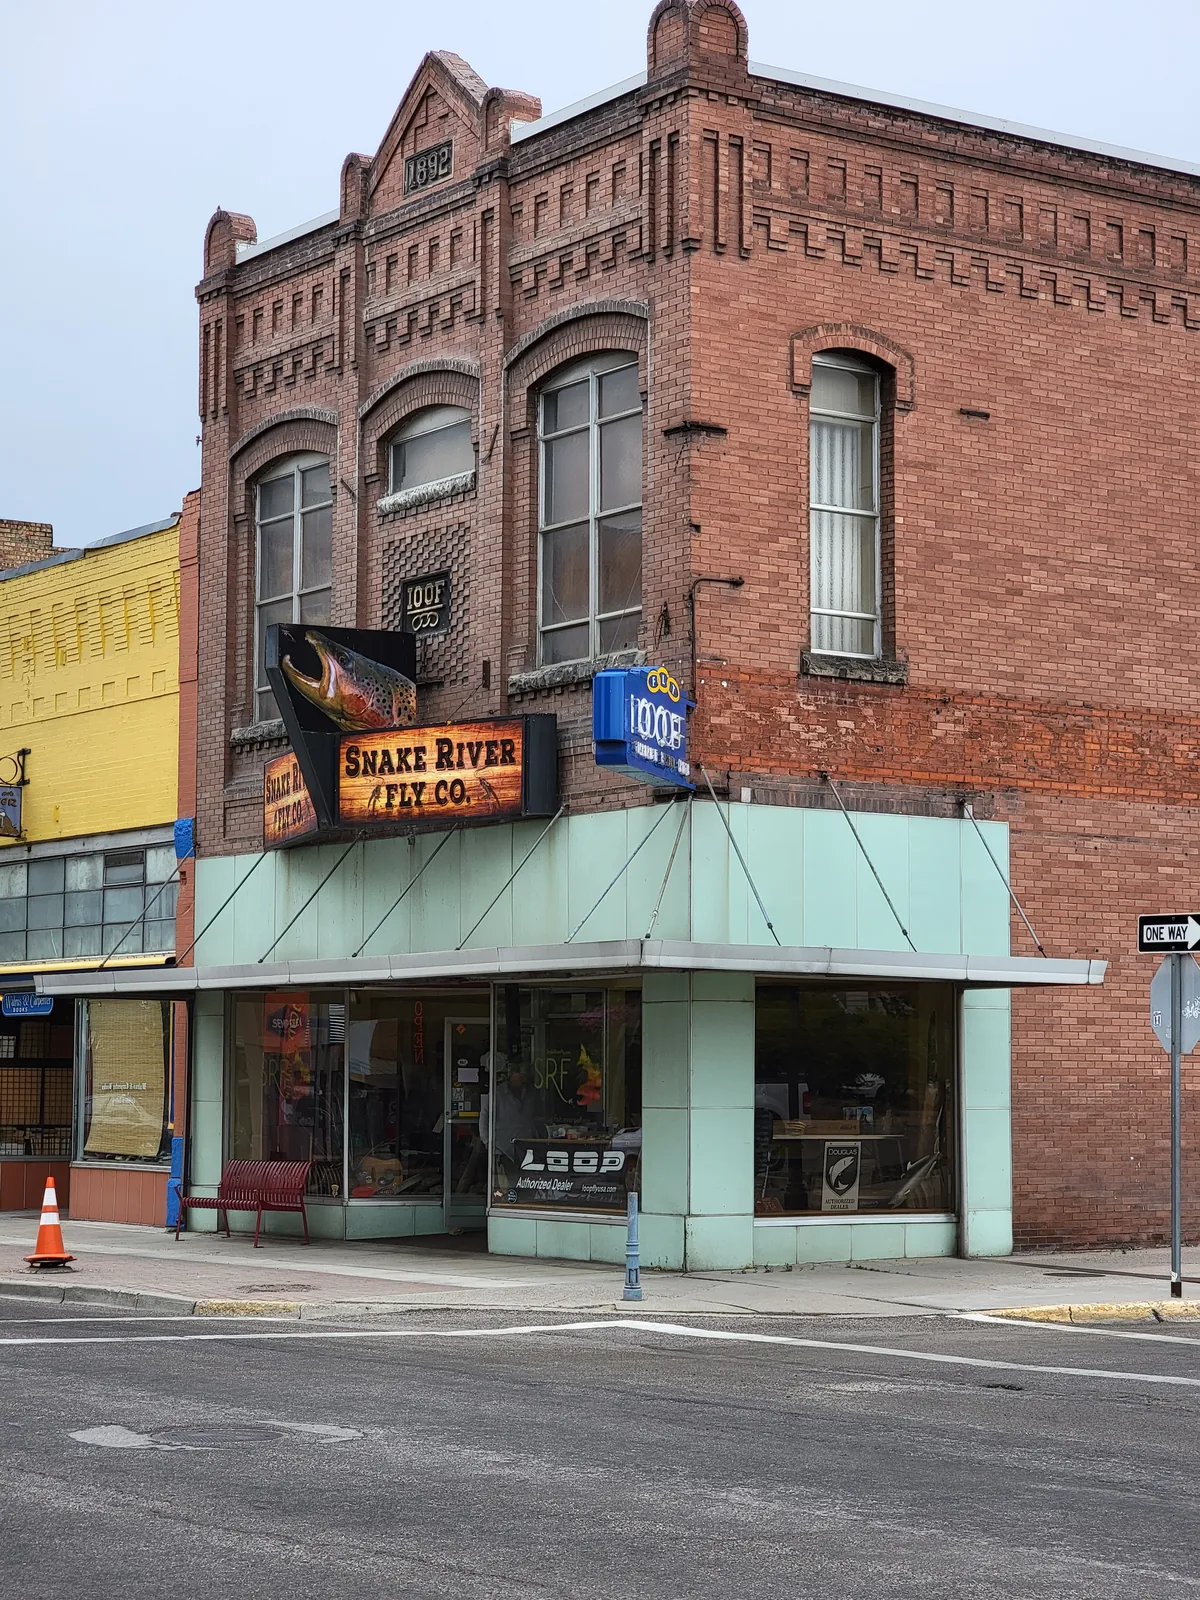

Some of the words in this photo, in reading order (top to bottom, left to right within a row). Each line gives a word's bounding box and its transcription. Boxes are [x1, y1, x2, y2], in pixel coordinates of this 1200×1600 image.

[408, 146, 449, 187] 1892
[407, 580, 445, 609] IOOF
[345, 745, 427, 778] SNAKE
[435, 738, 517, 771] RIVER
[266, 772, 291, 805] SNAKE
[385, 781, 426, 809] FLY
[435, 778, 472, 805] CO.
[278, 804, 291, 832] FLY
[1145, 926, 1165, 941] ONE
[1168, 925, 1188, 940] WAY
[534, 1057, 572, 1091] SRF
[828, 1148, 857, 1156] DOUGLAS
[516, 1177, 551, 1190] Authorized
[551, 1179, 573, 1191] Dealer
[581, 1184, 617, 1193] loopflyusa.com
